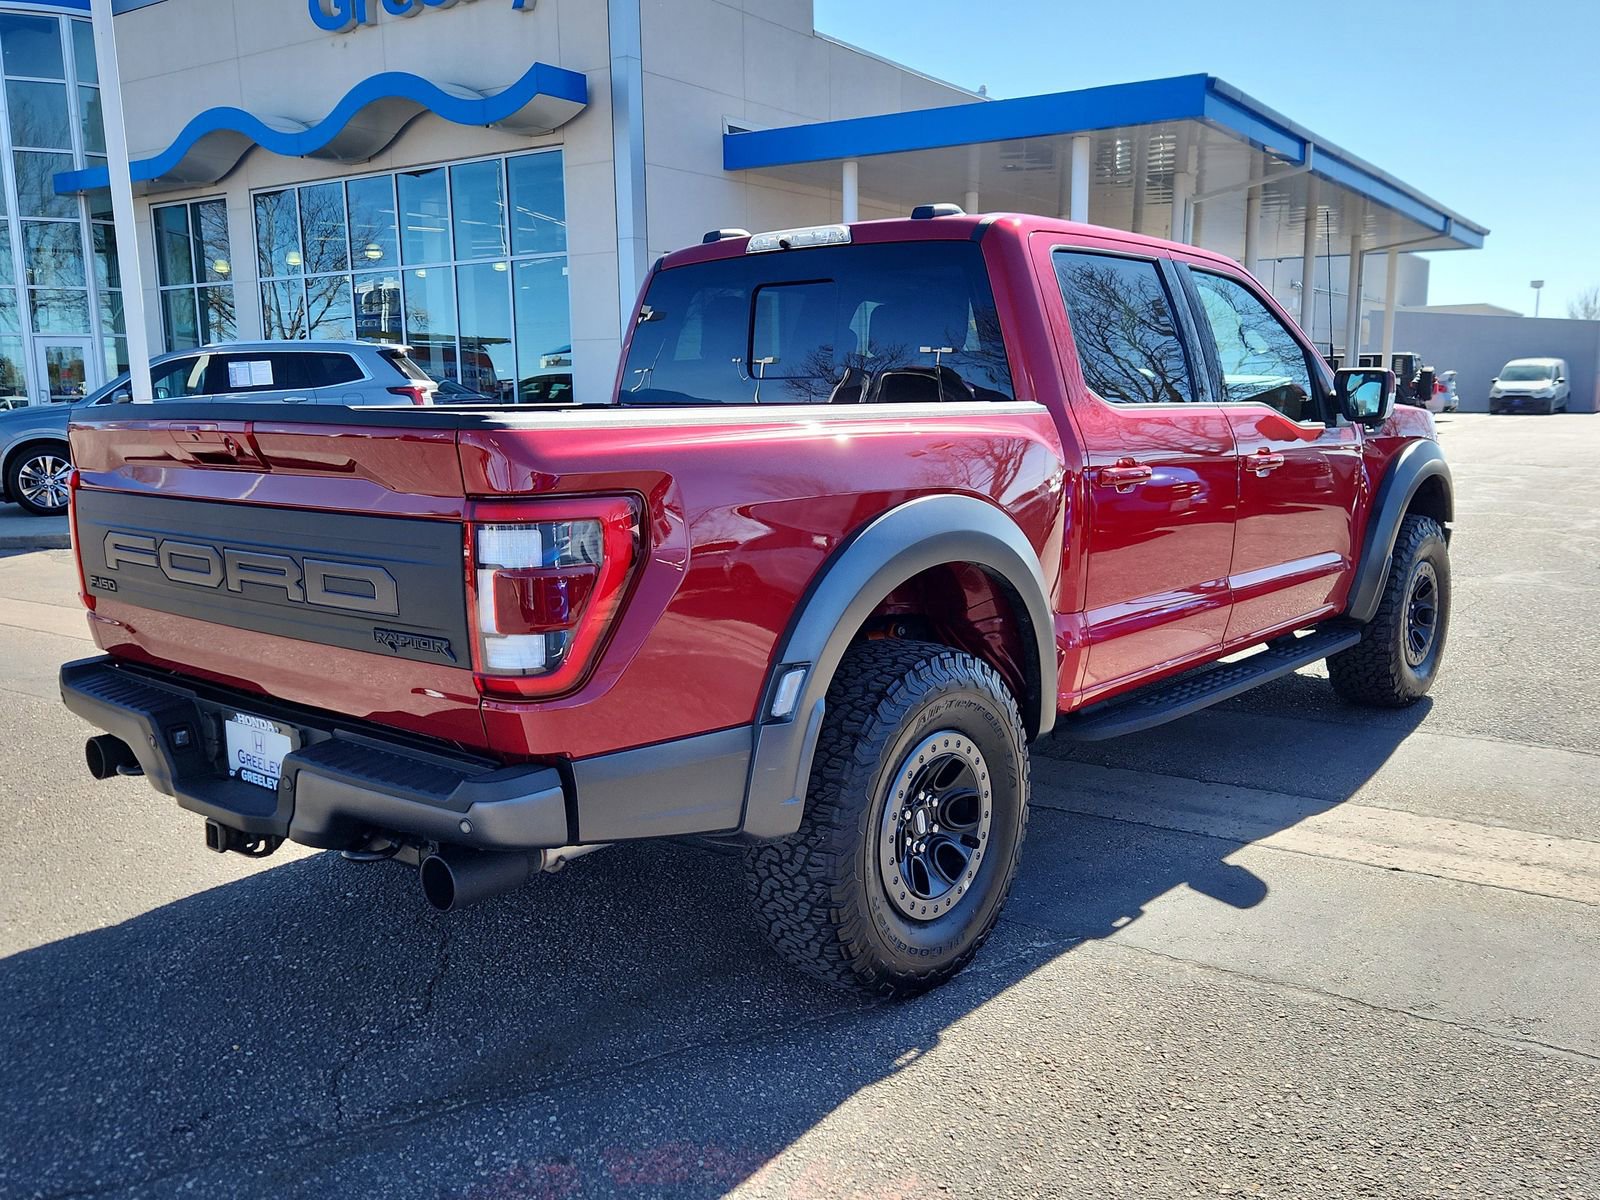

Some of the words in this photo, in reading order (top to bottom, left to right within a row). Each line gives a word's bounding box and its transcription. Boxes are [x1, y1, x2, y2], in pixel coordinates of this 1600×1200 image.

[103, 531, 400, 616] FORD
[373, 627, 457, 663] RAPTOR
[236, 713, 275, 732] HONDA
[237, 749, 281, 777] GREELEY
[241, 769, 278, 791] GREELEY
